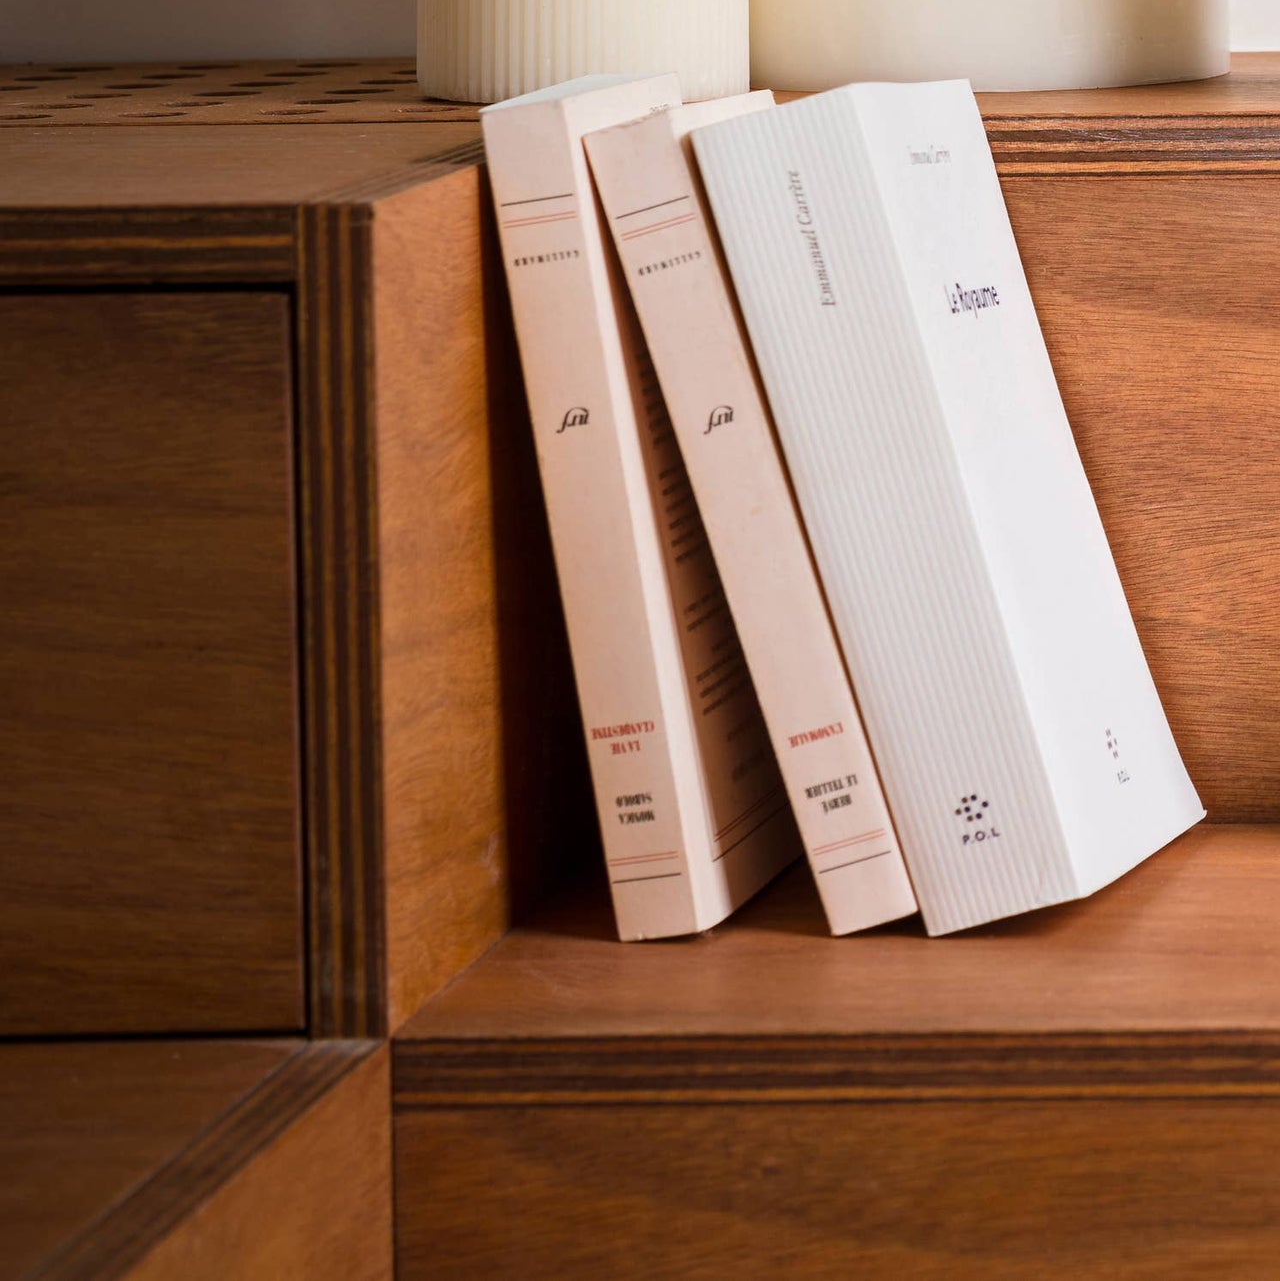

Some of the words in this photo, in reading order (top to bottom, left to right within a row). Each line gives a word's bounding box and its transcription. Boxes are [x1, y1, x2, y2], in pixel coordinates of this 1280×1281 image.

[787, 169, 812, 227] Carrère
[800, 229, 836, 307] Emmanuel
[955, 282, 1000, 319] Royaume
[590, 720, 655, 740] CLANDESTINE
[610, 741, 627, 755] VIE
